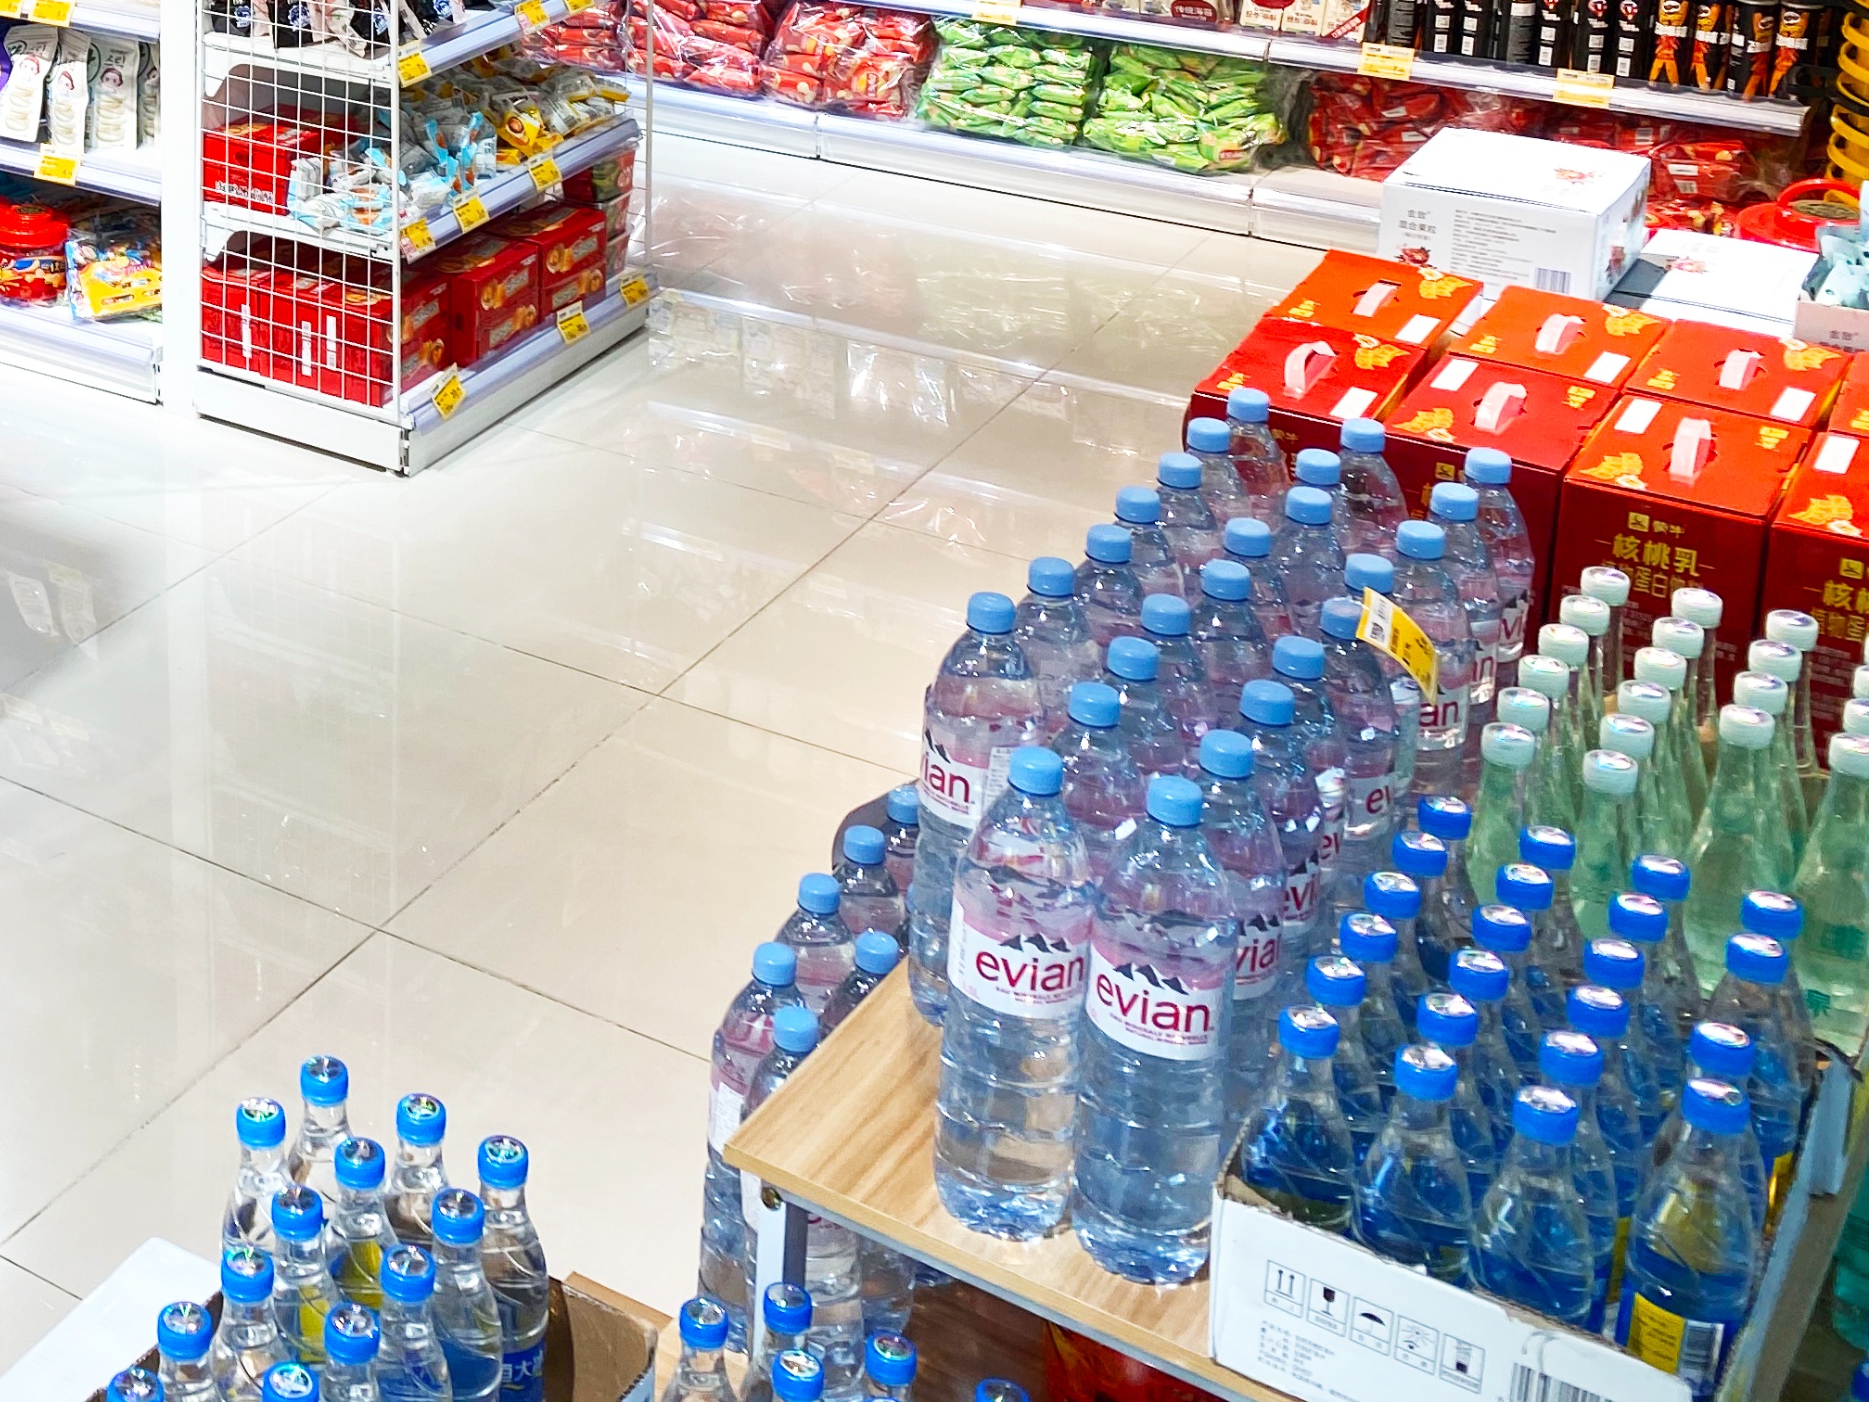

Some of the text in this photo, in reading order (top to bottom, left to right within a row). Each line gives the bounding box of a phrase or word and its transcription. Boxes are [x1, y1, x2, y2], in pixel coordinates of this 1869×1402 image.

[1652, 521, 1685, 540] 蒙牛
[1612, 534, 1699, 578] 核桃乳
[976, 950, 1085, 992] evian
[1096, 974, 1211, 1033] evian
